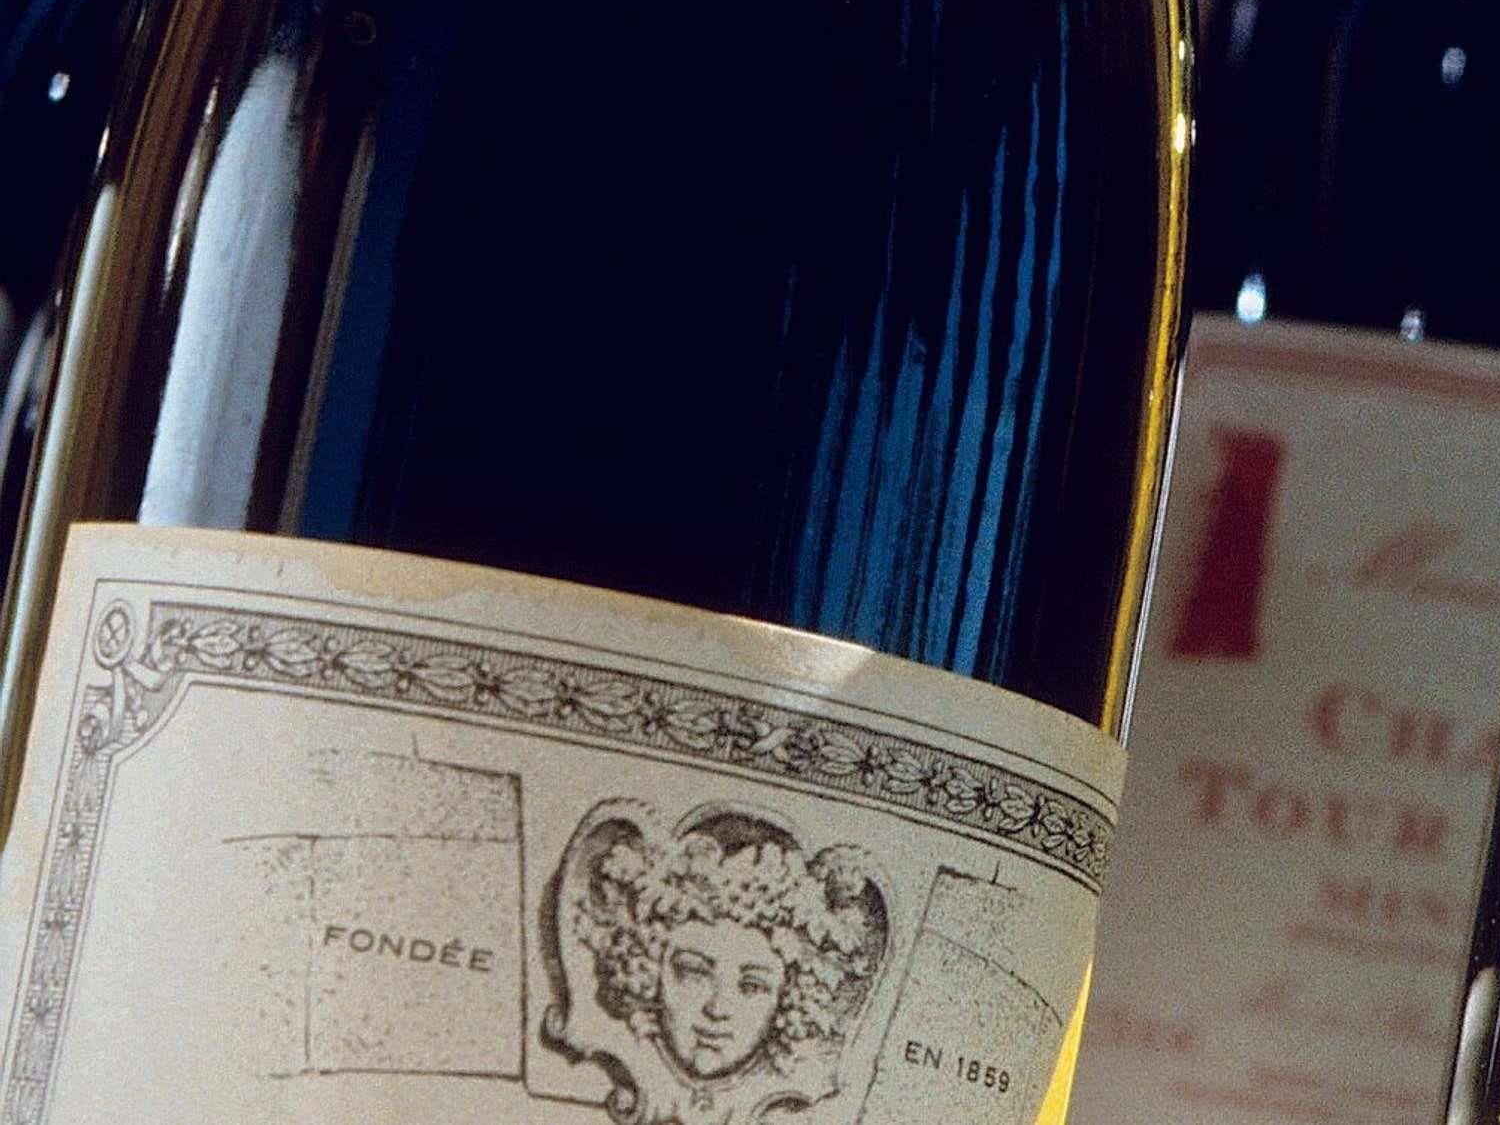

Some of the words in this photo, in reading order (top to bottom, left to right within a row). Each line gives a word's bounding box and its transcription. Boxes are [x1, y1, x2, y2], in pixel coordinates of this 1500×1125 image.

[323, 925, 494, 973] FONDÉE
[904, 1039, 943, 1070] EN
[956, 1056, 1010, 1093] 1859
